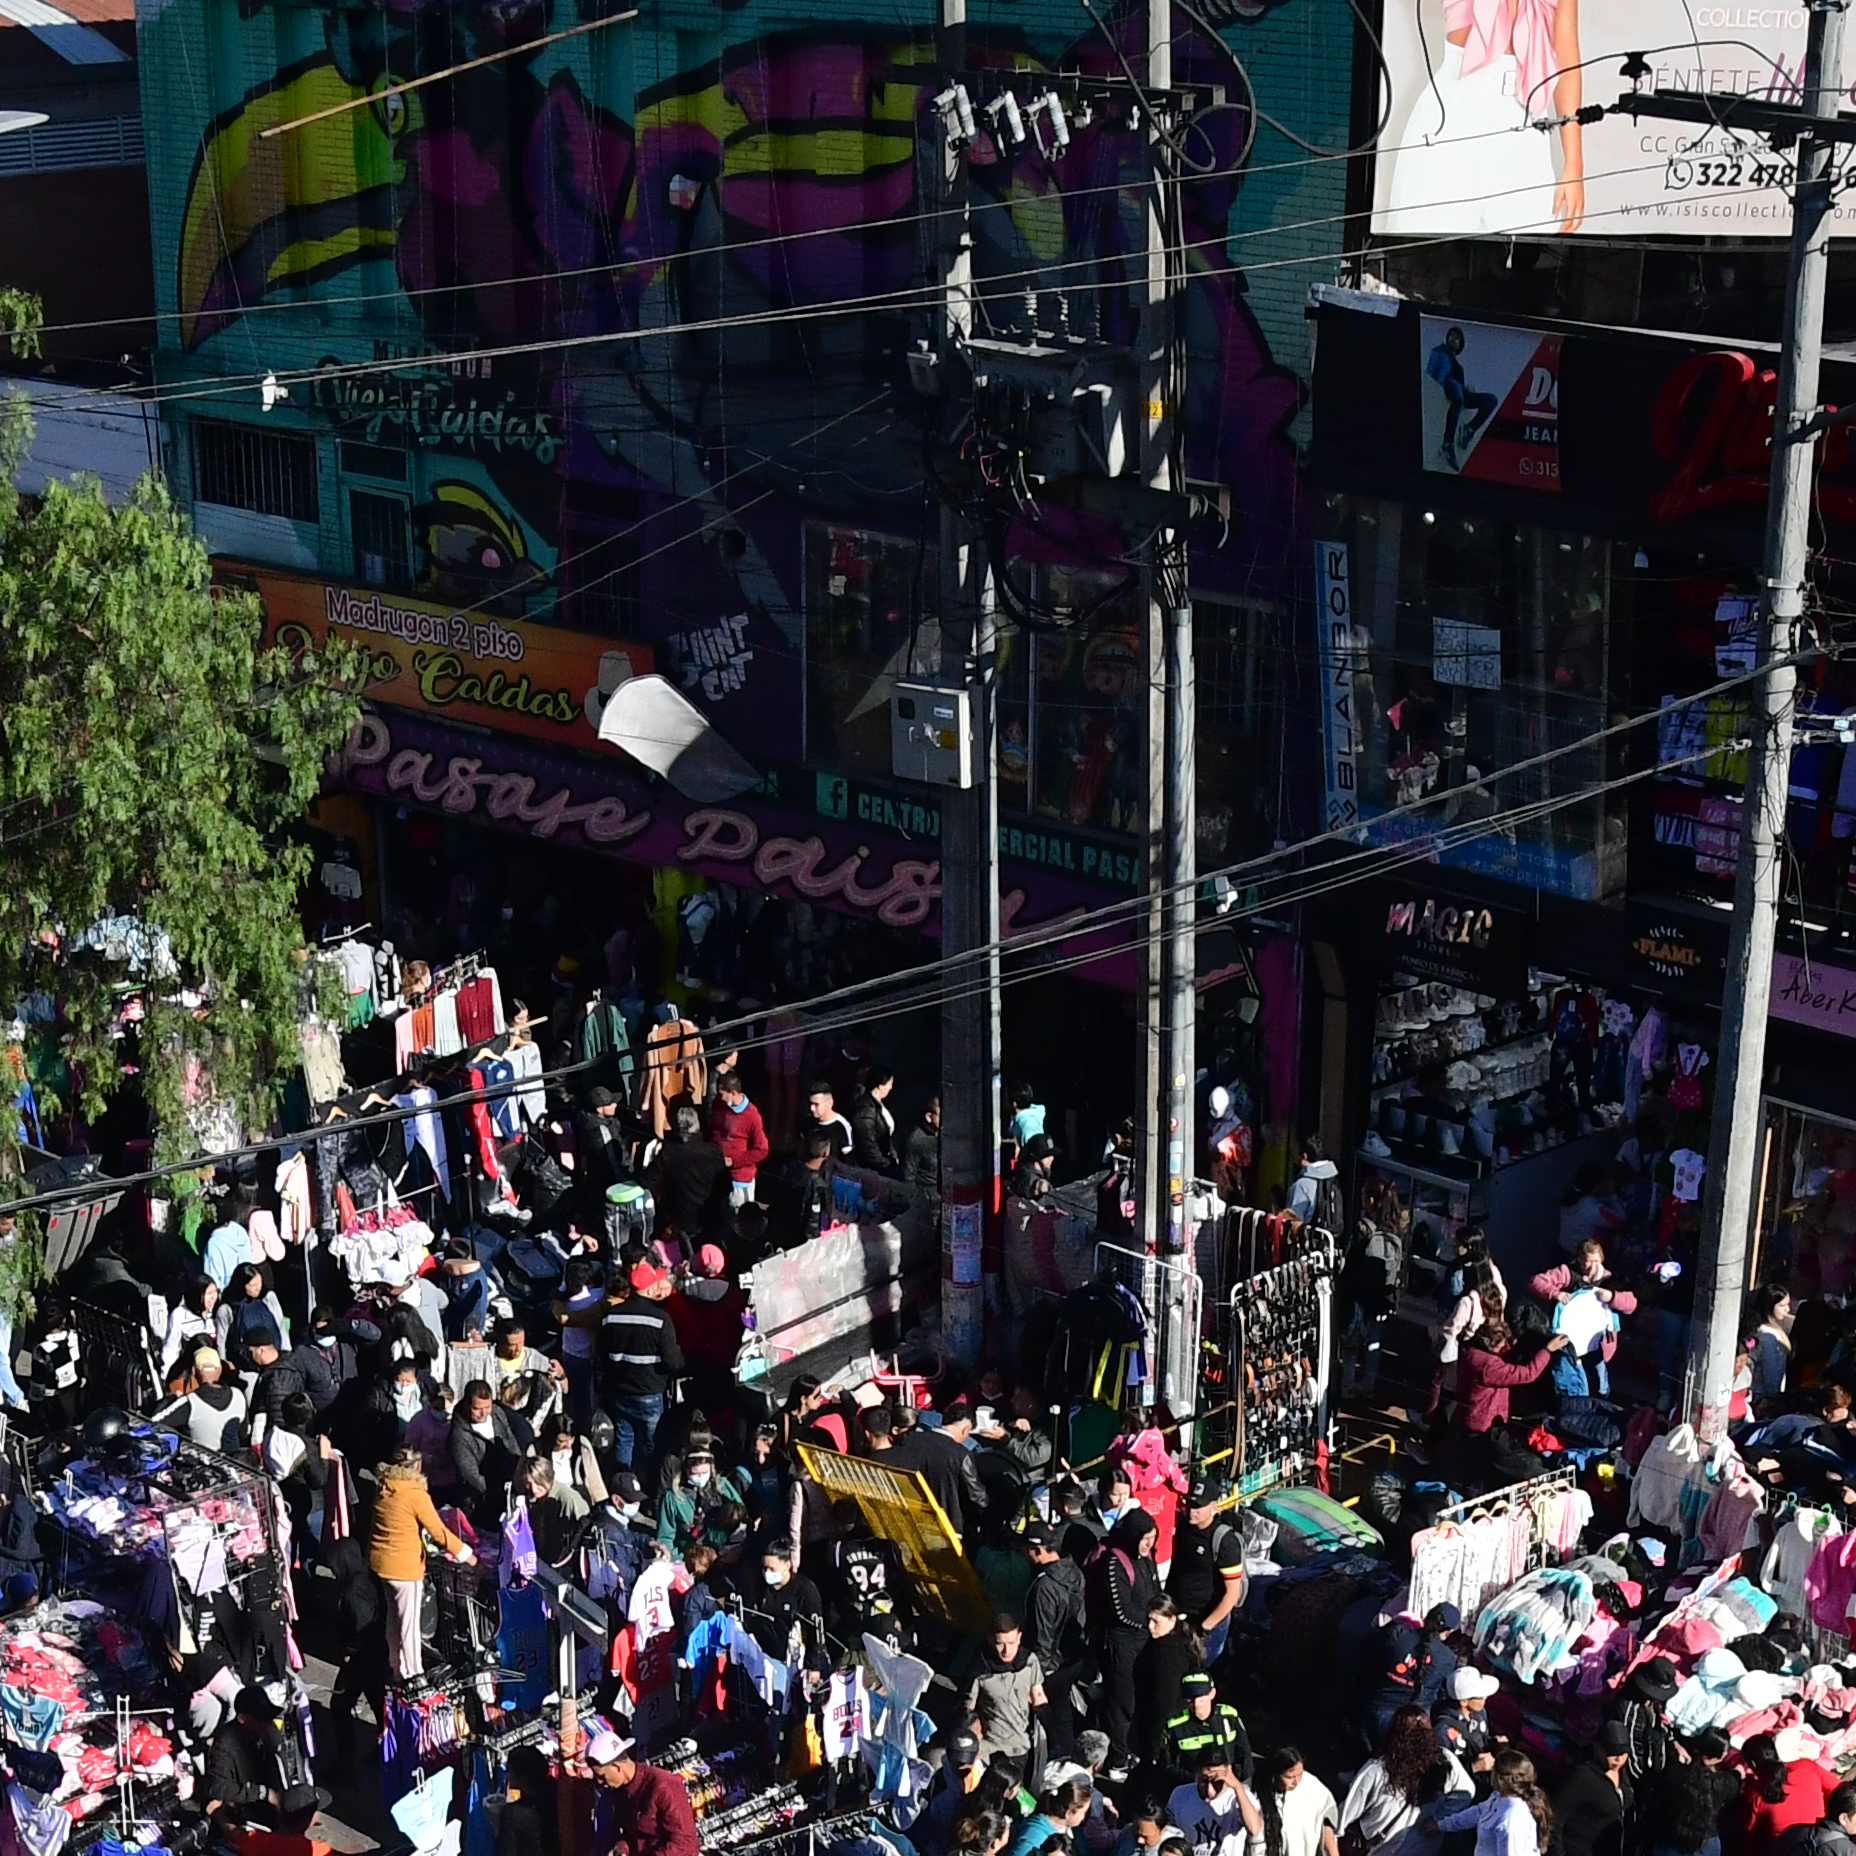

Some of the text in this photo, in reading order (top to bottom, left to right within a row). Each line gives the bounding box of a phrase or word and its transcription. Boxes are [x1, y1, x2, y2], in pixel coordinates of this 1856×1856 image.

[1696, 7, 1808, 30] COLLECTIO
[1697, 163, 1742, 187] 322
[1523, 425, 1558, 442] JEA
[325, 586, 525, 661] Madrugon 2 piso
[412, 650, 582, 724] Caldas
[1327, 550, 1356, 791] BLANBOR
[1383, 897, 1495, 950] MAGIC
[849, 1562, 887, 1593] 94
